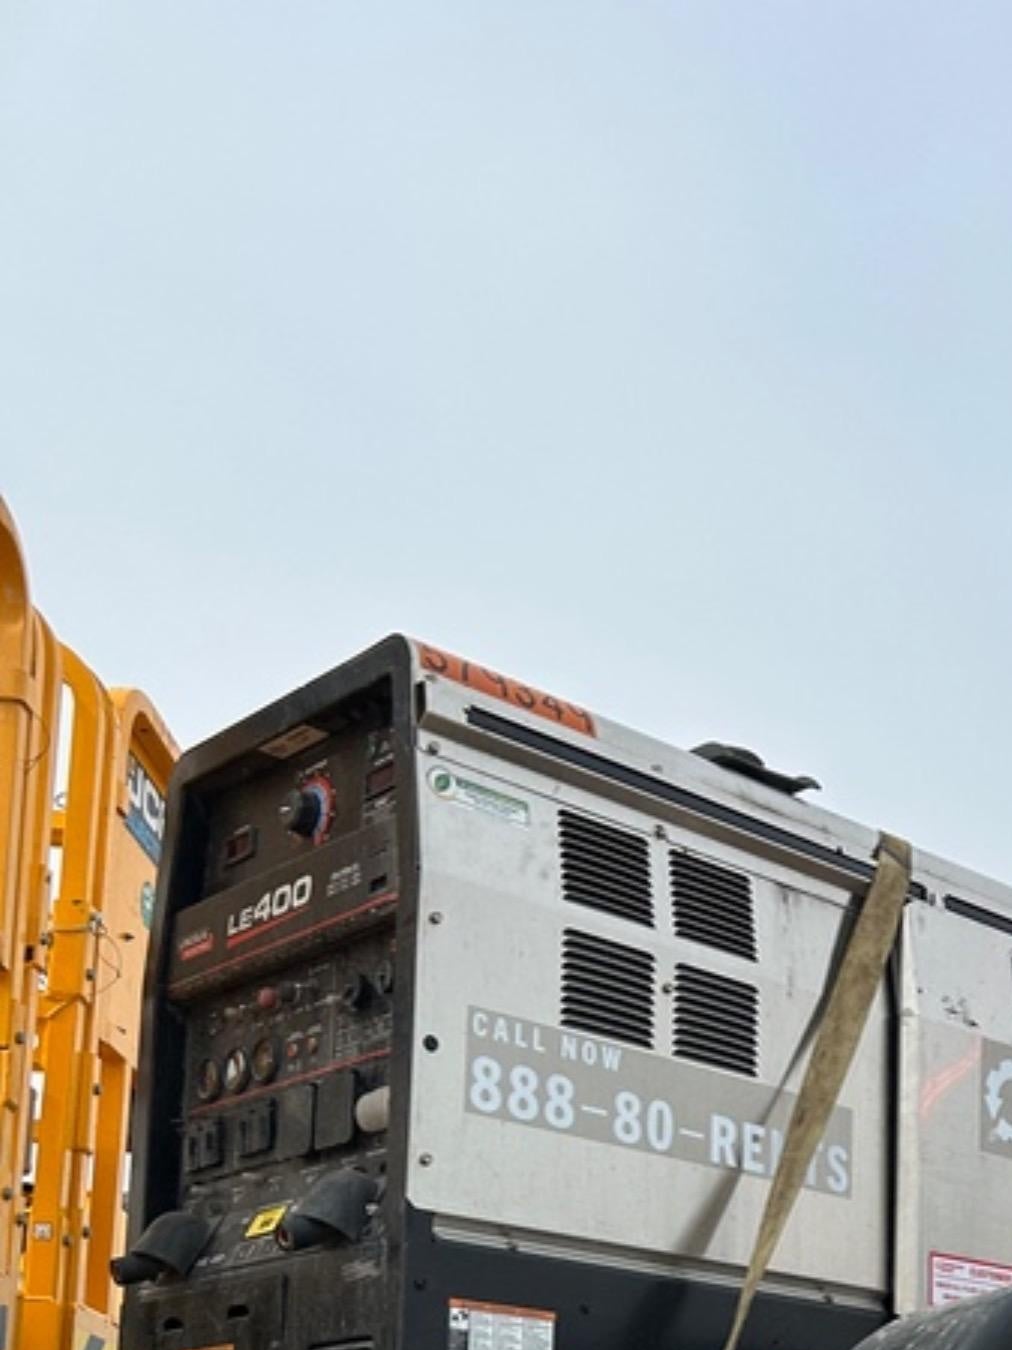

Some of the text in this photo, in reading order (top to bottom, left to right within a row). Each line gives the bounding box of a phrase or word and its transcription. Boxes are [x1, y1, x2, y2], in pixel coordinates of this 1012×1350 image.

[227, 874, 313, 935] LE400
[472, 1011, 623, 1073] CALL NOW
